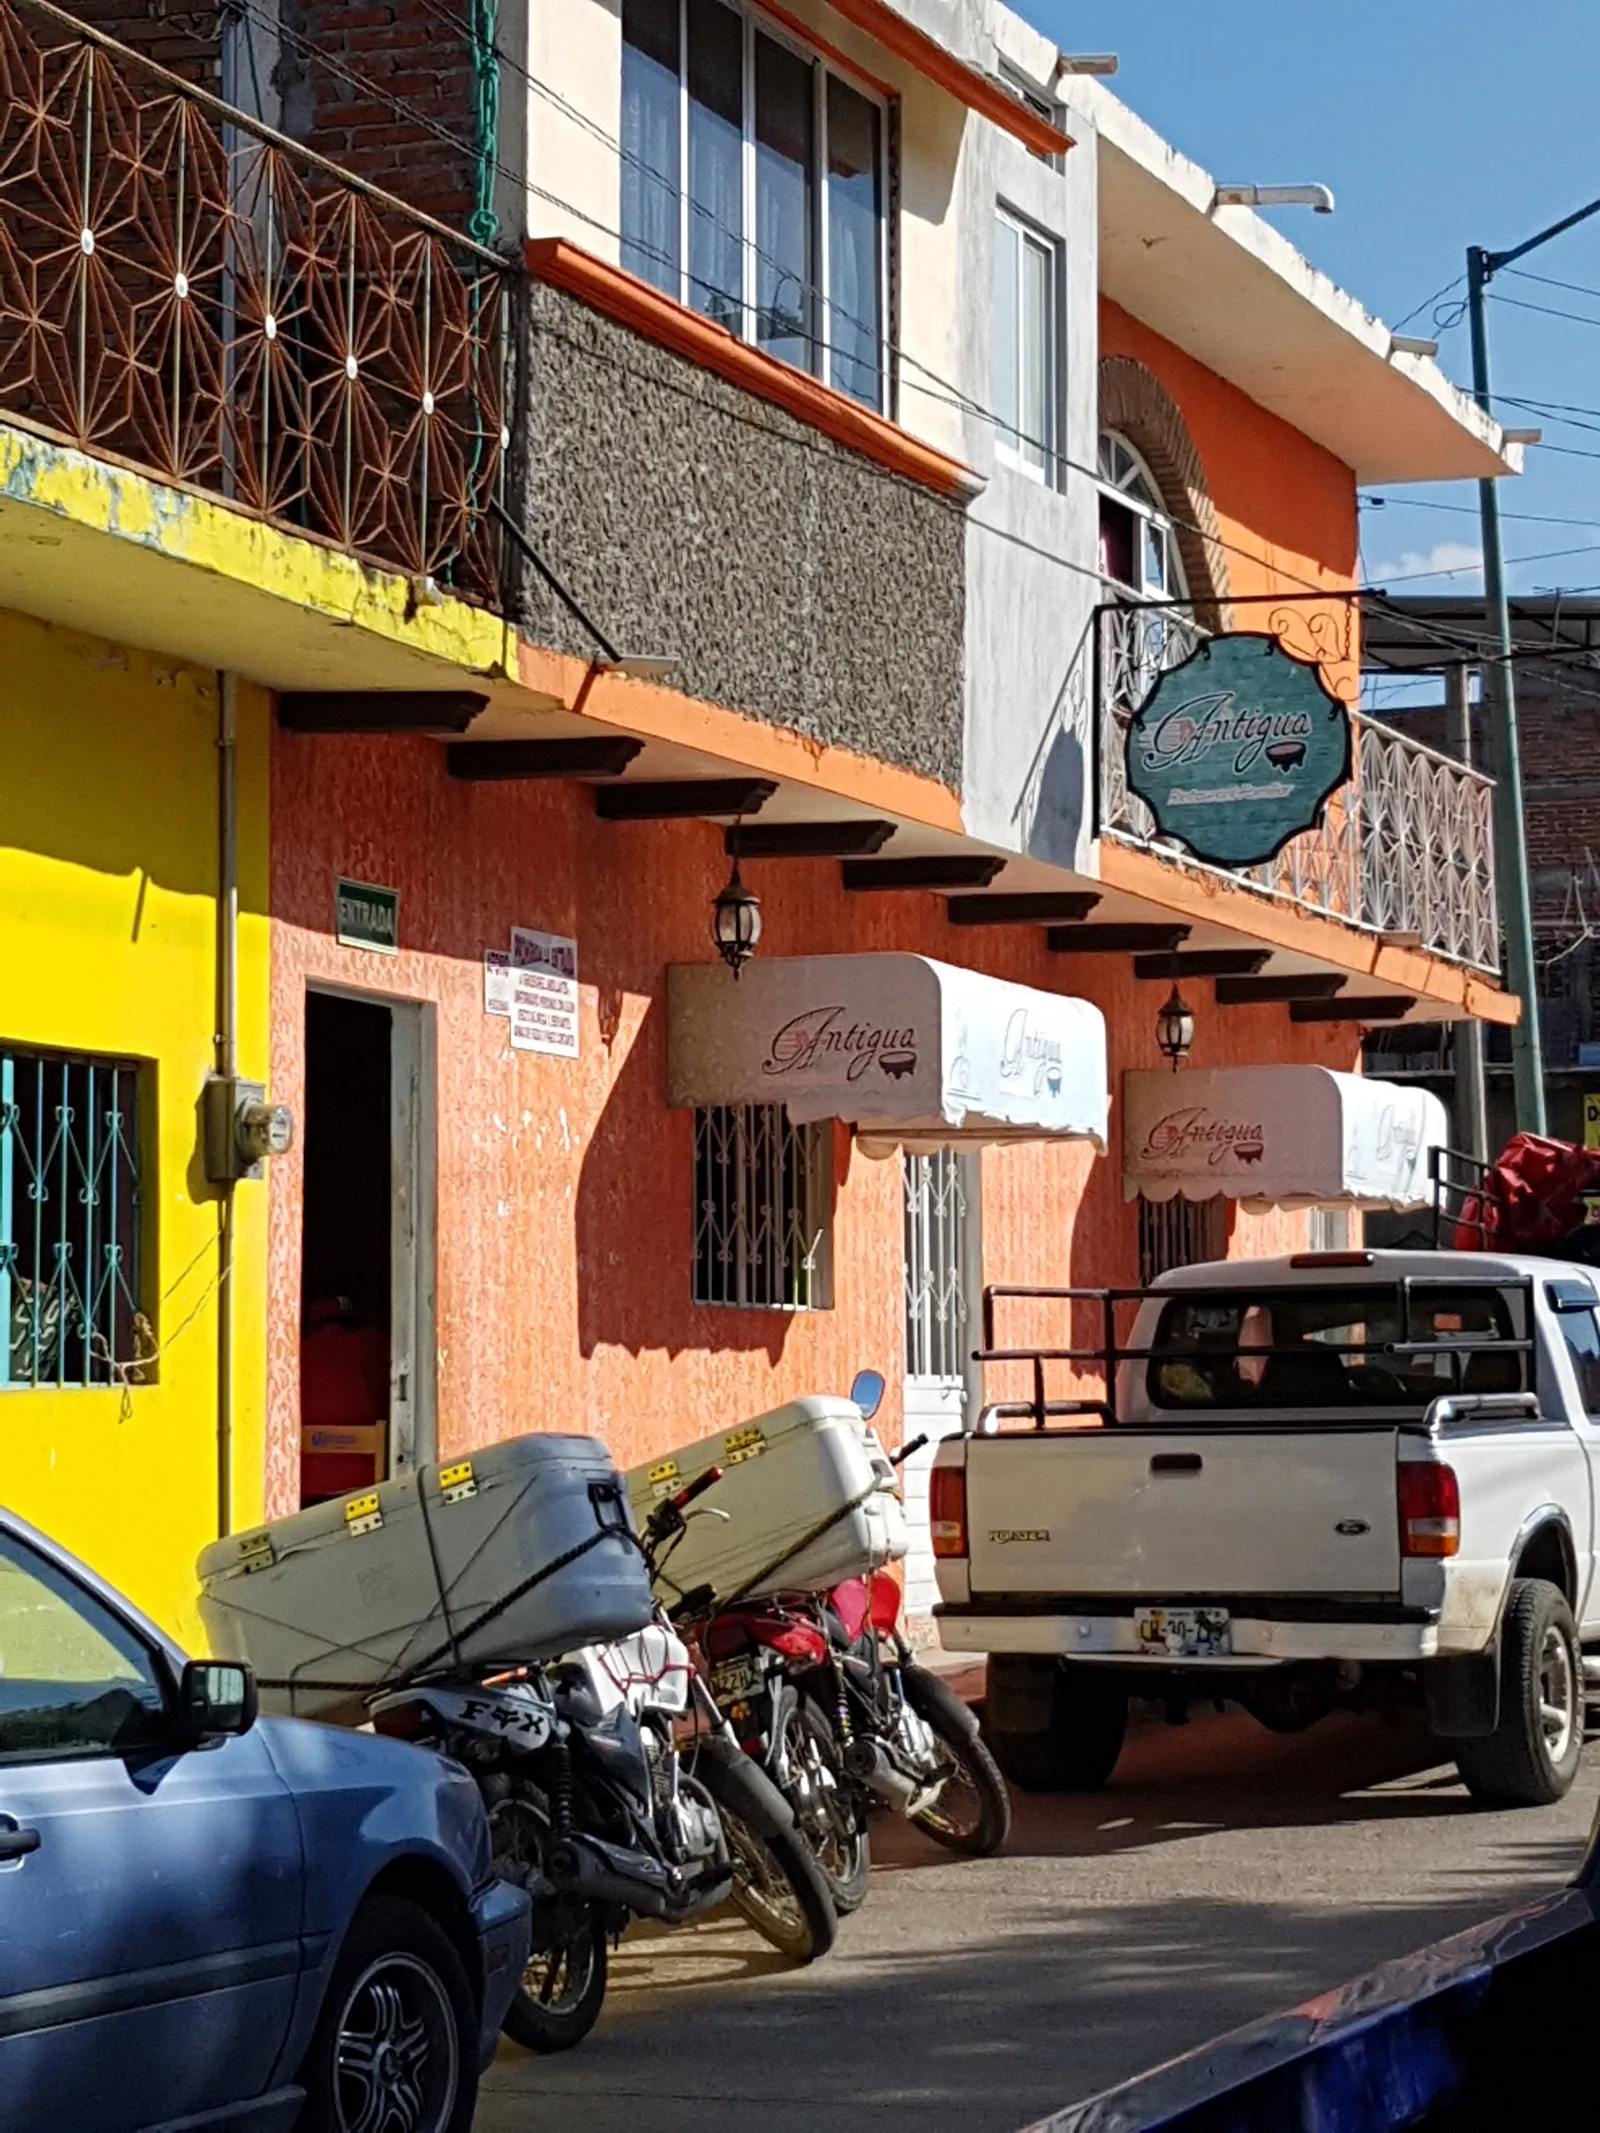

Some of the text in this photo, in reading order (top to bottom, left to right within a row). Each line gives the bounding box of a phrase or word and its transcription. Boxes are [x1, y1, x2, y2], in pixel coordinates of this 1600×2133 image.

[1144, 692, 1310, 773] Antigua
[340, 896, 395, 936] ENTRADA
[762, 1006, 918, 1082] Antigua
[1140, 1106, 1264, 1165] Antigua
